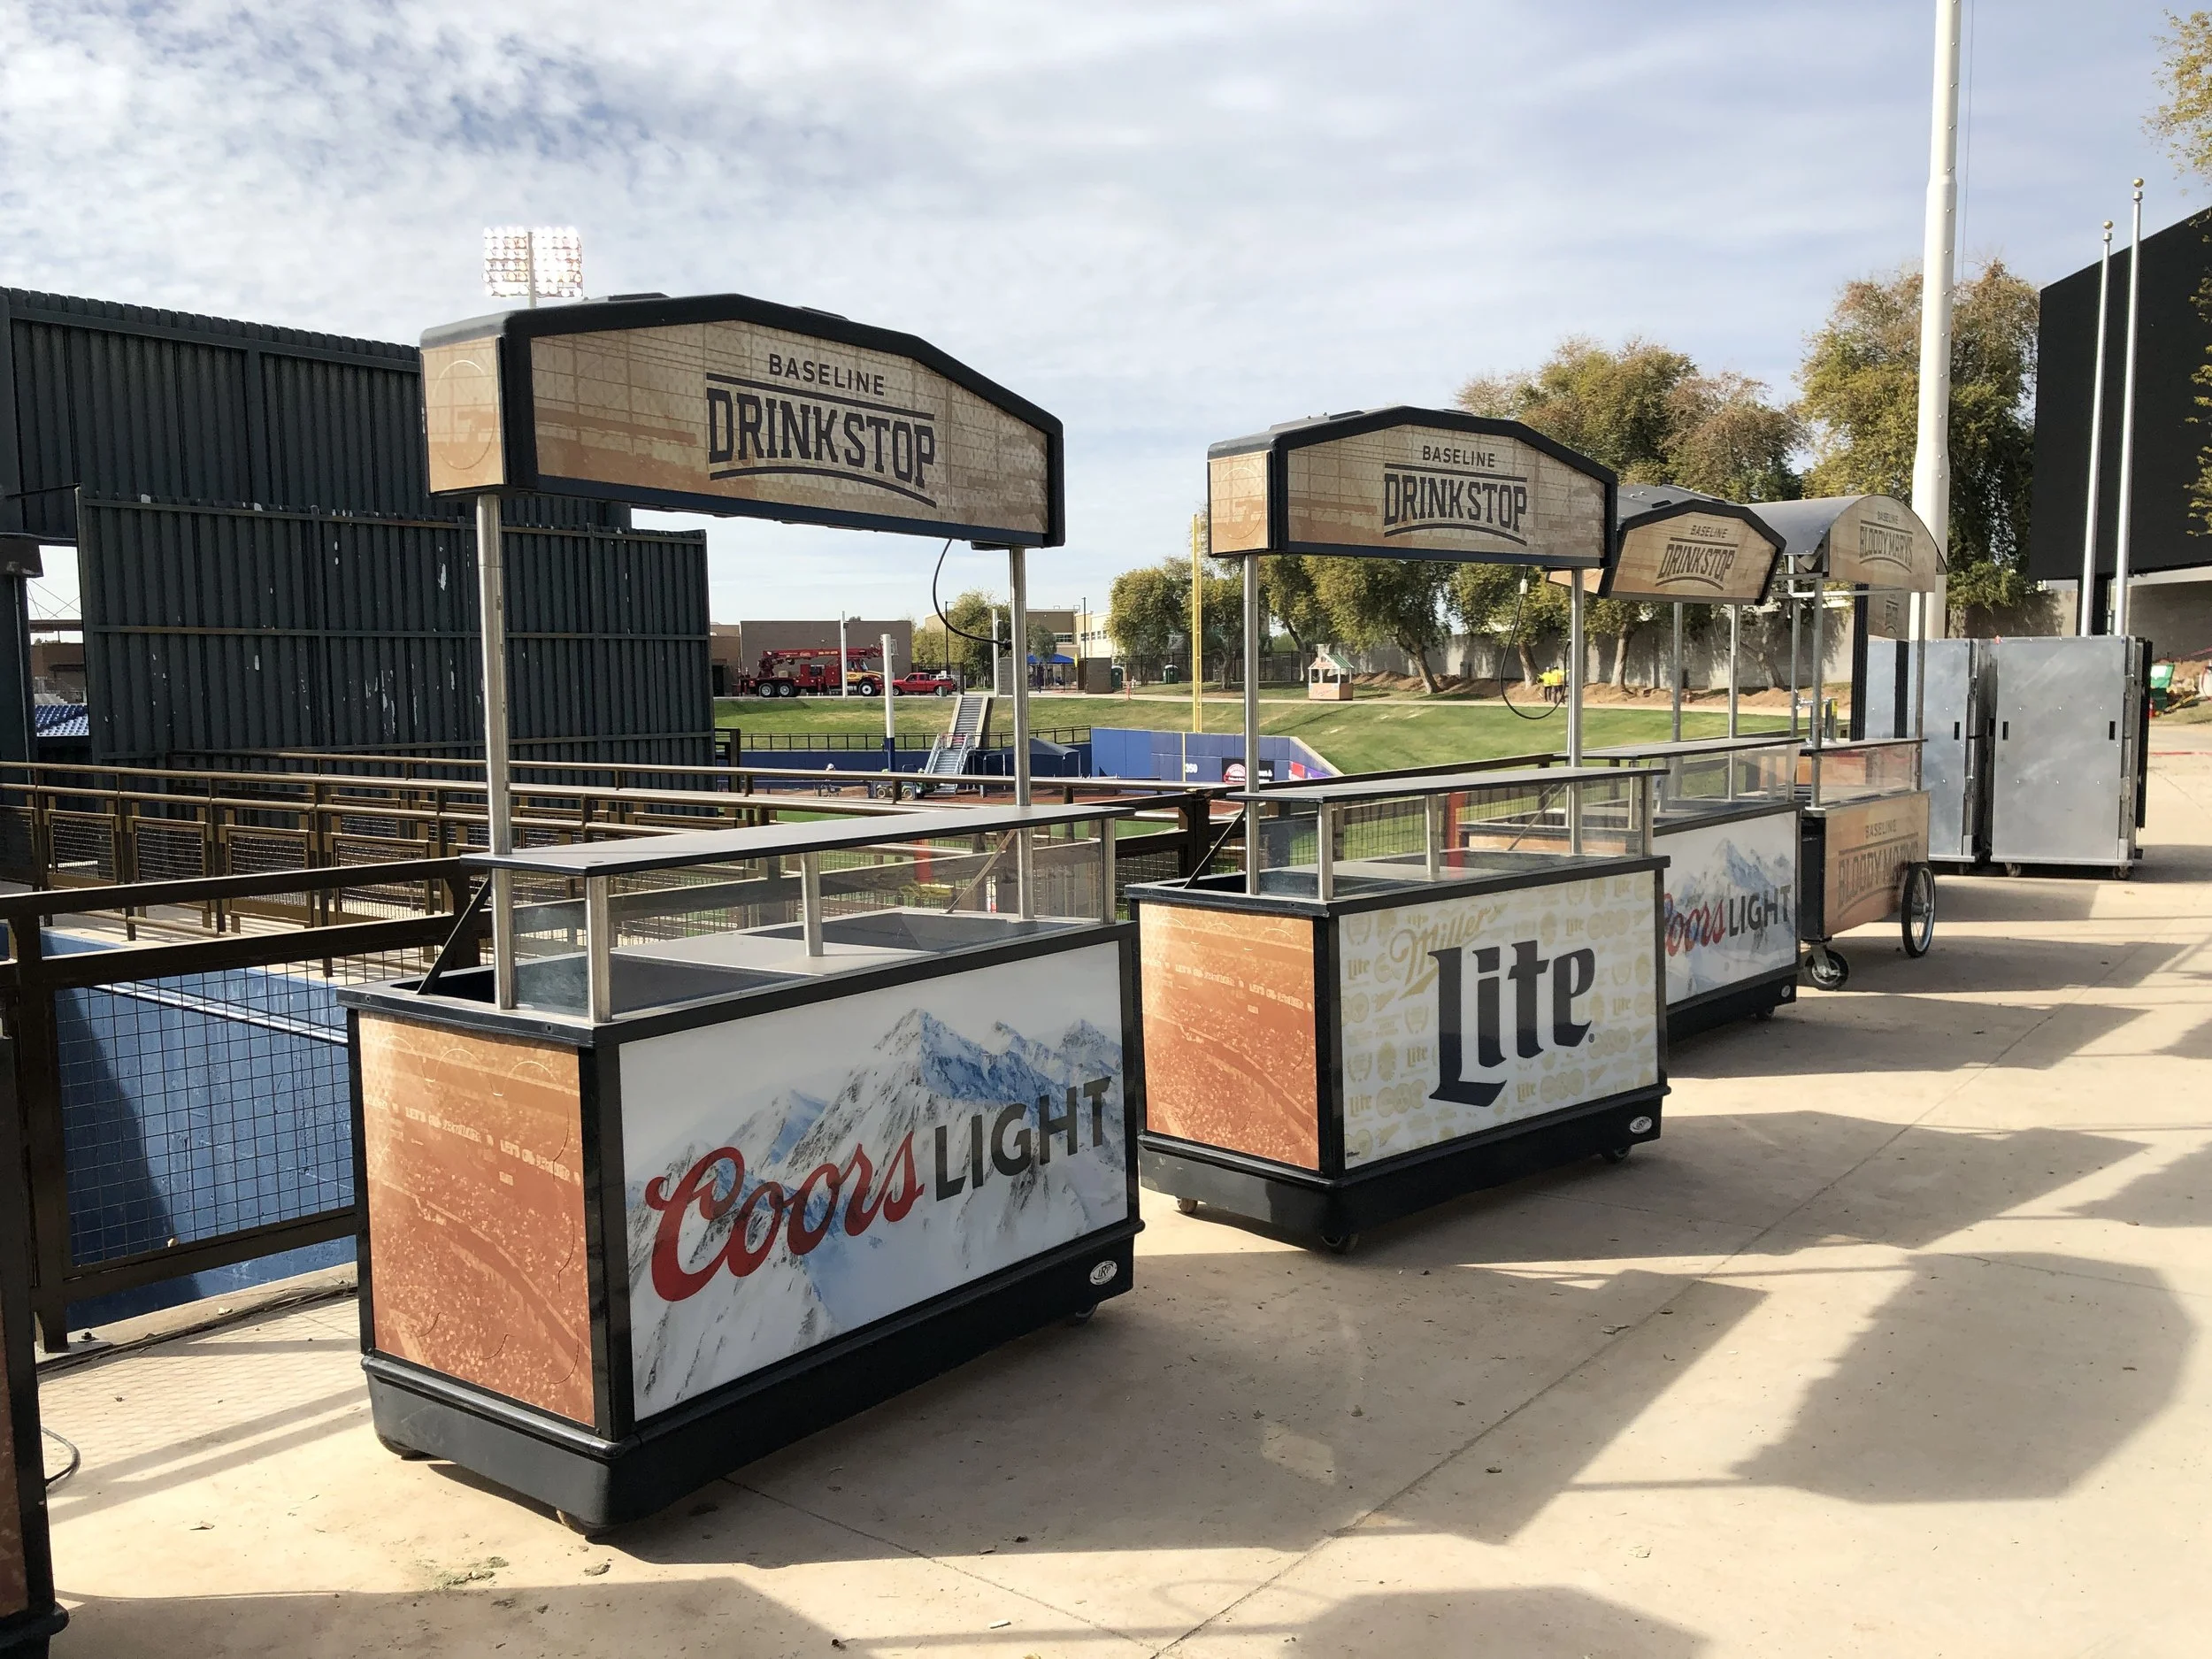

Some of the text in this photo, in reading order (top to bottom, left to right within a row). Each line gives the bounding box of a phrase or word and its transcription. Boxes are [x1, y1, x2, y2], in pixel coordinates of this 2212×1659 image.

[770, 353, 885, 396] BASELINE
[707, 387, 934, 488] DRINKSTOP
[1422, 445, 1495, 468] BASELINE
[1384, 472, 1527, 533] DRINKSTOP
[1690, 524, 1729, 539] BASELINE
[1656, 543, 1736, 582] DRINKSTOP
[1865, 818, 1897, 840] BASELINE
[1390, 905, 1491, 987] Miller
[1664, 885, 1792, 957] oors LIGHT
[1427, 940, 1595, 1107] Lite
[645, 1075, 1112, 1302] Coors LIGHT
